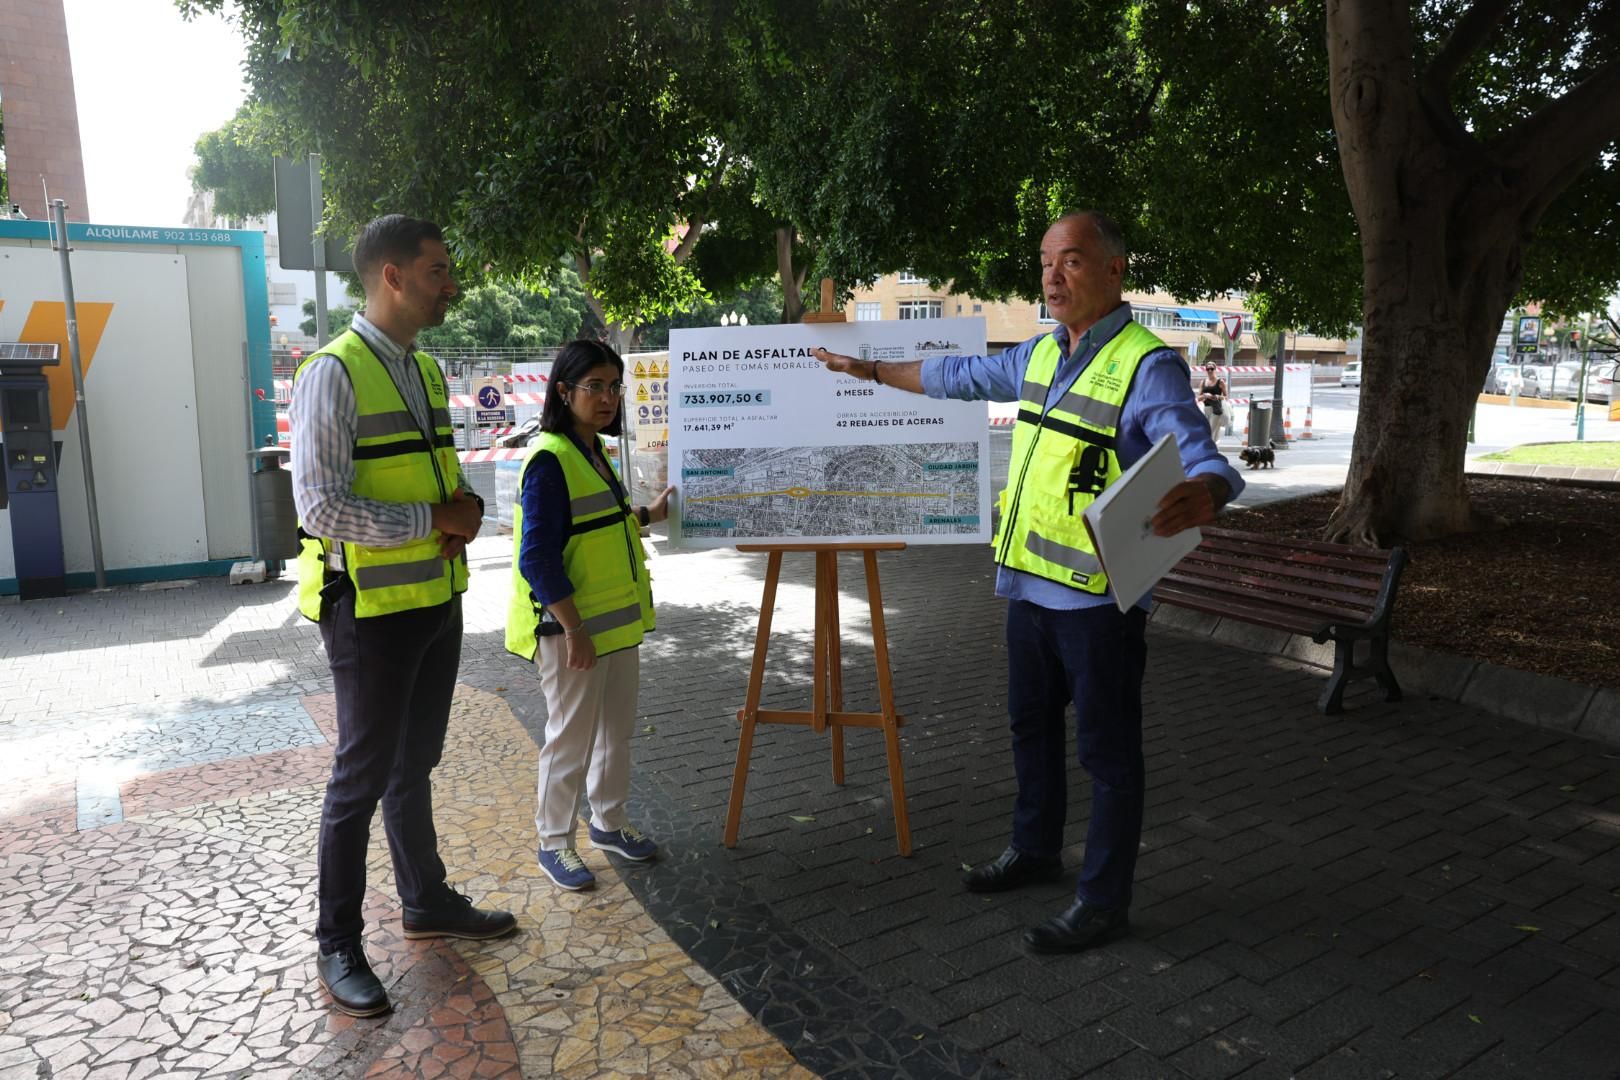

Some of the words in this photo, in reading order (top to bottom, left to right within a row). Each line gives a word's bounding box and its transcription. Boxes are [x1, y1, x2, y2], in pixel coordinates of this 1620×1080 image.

[86, 227, 159, 240] ALQUÍLAME
[165, 232, 184, 241] 902
[188, 232, 208, 241] 153
[211, 233, 230, 242] 688
[683, 351, 718, 362] PLAN
[722, 350, 740, 360] DE
[682, 364, 714, 373] PASEO
[736, 361, 769, 371] TOMÁS
[774, 361, 820, 370] MORALES
[684, 393, 751, 405] 733.907,50
[754, 392, 763, 402] €
[684, 423, 721, 432] 17.641,39
[850, 419, 889, 427] REBAJES
[907, 418, 944, 426] ACERAS
